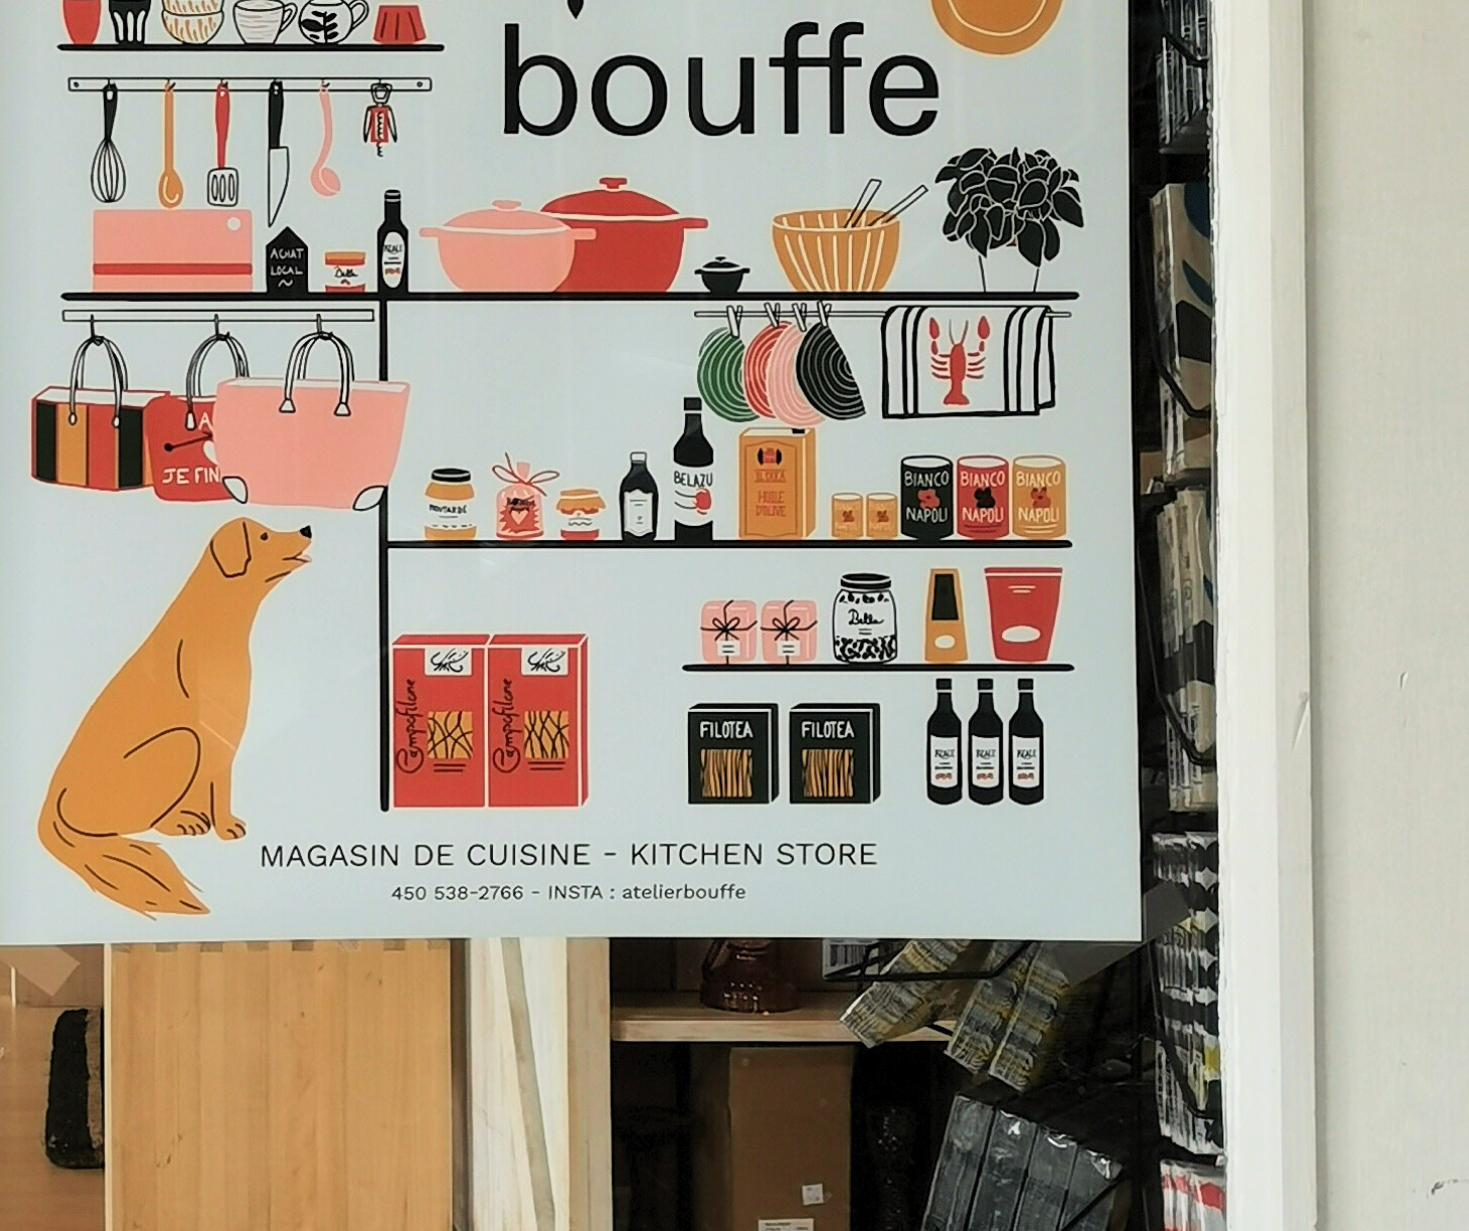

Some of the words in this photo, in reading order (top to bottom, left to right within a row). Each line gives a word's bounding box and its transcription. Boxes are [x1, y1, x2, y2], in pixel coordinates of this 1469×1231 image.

[504, 22, 939, 136] bouffe
[270, 265, 304, 276] LOCAL
[162, 468, 190, 484] JE
[673, 470, 714, 487] BELAZU
[904, 470, 950, 488] BIANCO
[960, 470, 1006, 488] BIANCO
[1016, 470, 1062, 488] BIANCO
[905, 506, 948, 524] NAPOLI
[961, 506, 1004, 524] NAPOLI
[1018, 506, 1061, 524] NAPOLI
[699, 720, 754, 739] FILOTEA
[801, 720, 855, 739] FILOTEA
[261, 844, 399, 867] MAGASIN
[414, 844, 454, 866] DE
[467, 843, 591, 866] CUISINE
[631, 843, 763, 866] KITCHEN
[776, 842, 878, 866] STORE
[391, 886, 427, 900] 450
[434, 885, 524, 900] 538-2766
[548, 885, 604, 900] INSTA
[622, 883, 746, 900] atelierbouffe
